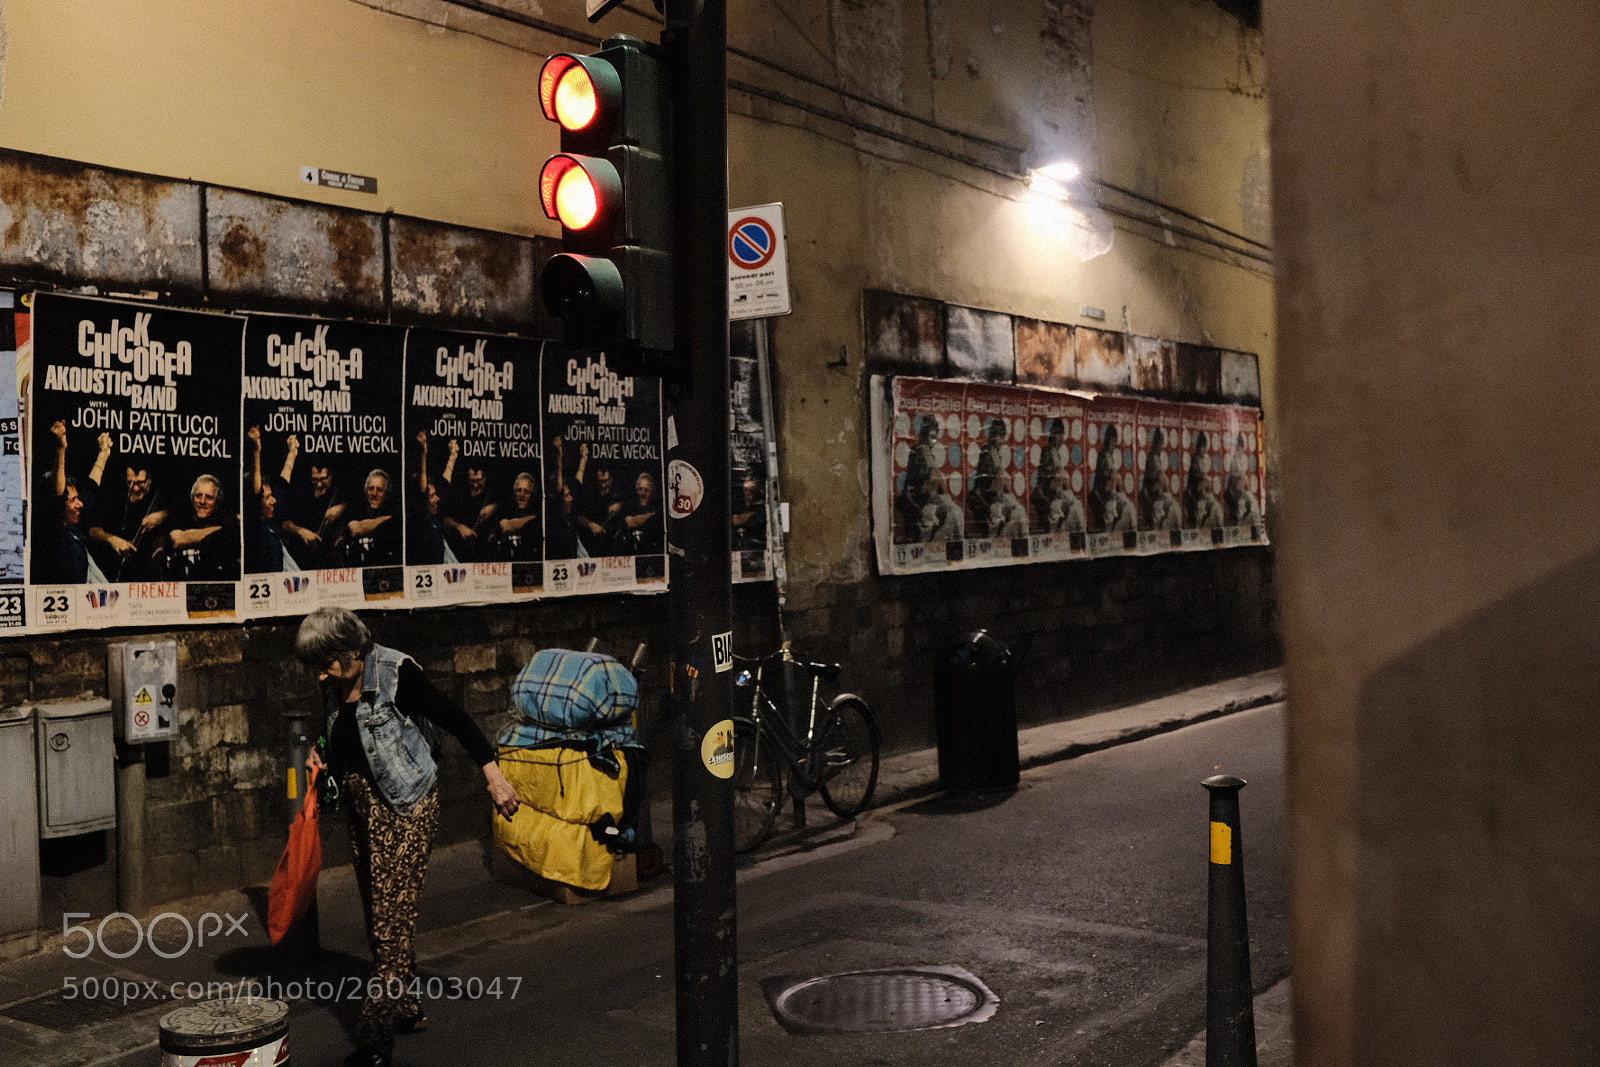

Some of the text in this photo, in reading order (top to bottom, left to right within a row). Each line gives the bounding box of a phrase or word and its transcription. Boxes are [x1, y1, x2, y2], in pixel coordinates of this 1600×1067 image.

[78, 312, 152, 368] CHICK
[267, 324, 329, 377] CHICK
[436, 339, 487, 386] CHICK
[44, 364, 177, 411] AKOUSTIC BAND
[242, 375, 350, 413] AKOUSTIC BAND
[412, 384, 503, 420] AKOUSTIC BAND
[548, 394, 626, 424] AKOUSTIC BAND
[71, 407, 218, 435] JOHN PATITUCCI
[264, 413, 386, 433] JOHN PATITUCCI
[430, 419, 532, 440] JOHN PATITUCCI
[304, 434, 398, 453] DAVE WECKL
[565, 425, 650, 443] JOHN PATITUCCI
[119, 433, 232, 458] DAVE WECKL
[463, 440, 541, 458] DAVE WECKL
[592, 443, 659, 460] DAVE WECKL
[677, 498, 691, 510] 30
[316, 568, 358, 584] FIRENZE
[415, 574, 433, 588] 23
[552, 568, 568, 581] 23
[129, 582, 180, 598] FIRENZE
[250, 584, 271, 598] 23
[0, 596, 21, 615] 23
[43, 596, 69, 612] 23
